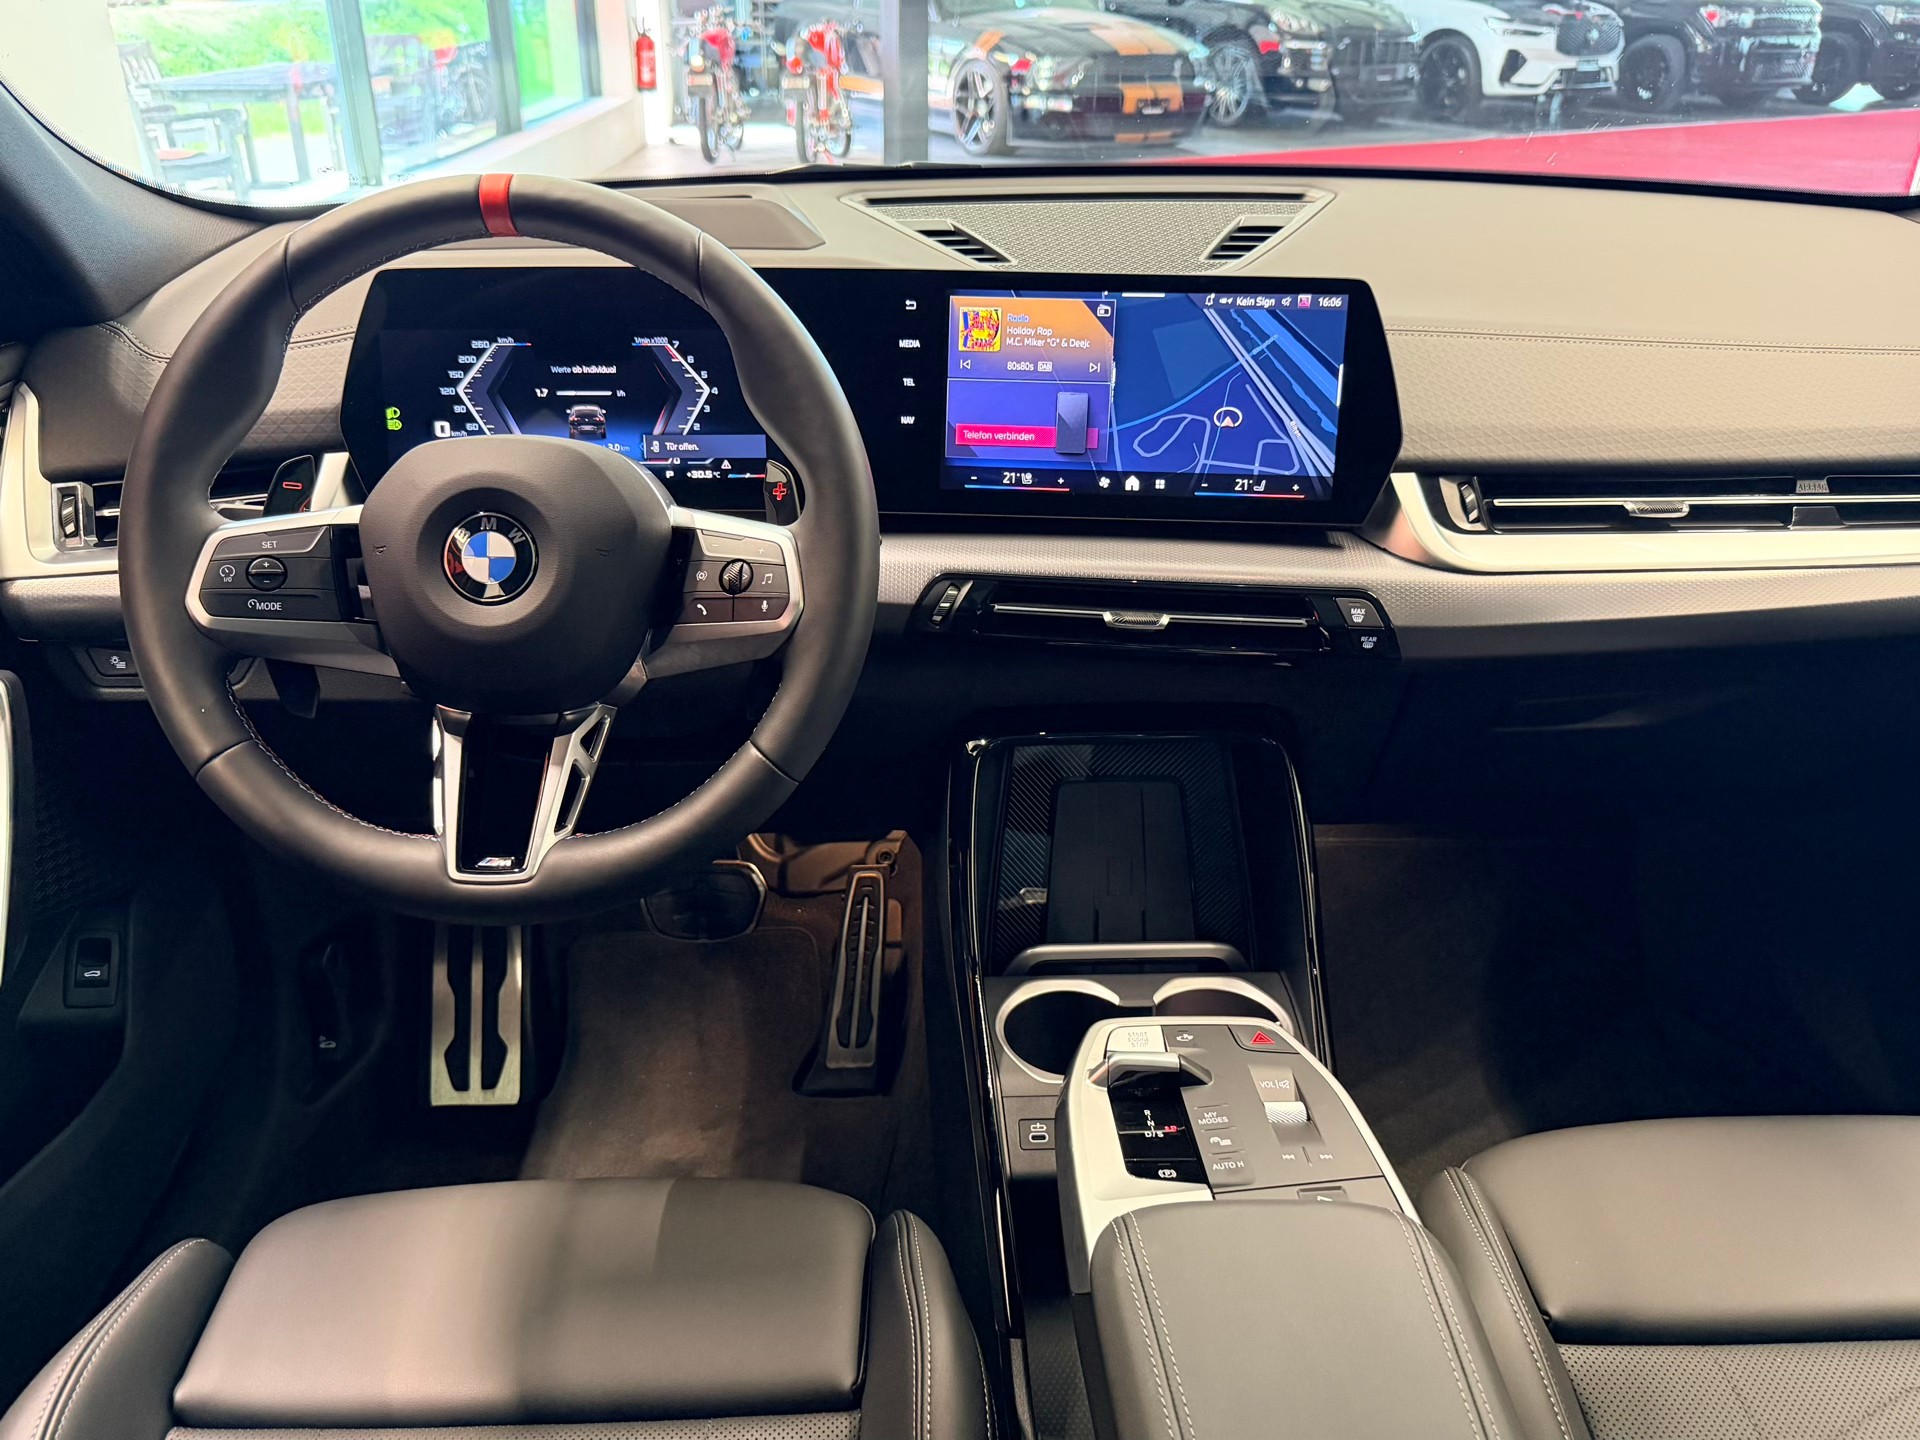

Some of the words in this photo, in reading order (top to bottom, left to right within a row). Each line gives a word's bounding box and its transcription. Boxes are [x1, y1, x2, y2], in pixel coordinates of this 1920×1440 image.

[1236, 296, 1255, 306] Kein
[1256, 296, 1275, 308] Sign
[1318, 297, 1342, 307] 16:06
[1007, 313, 1029, 323] Radio
[1006, 326, 1036, 337] Holiday
[1037, 327, 1053, 337] Rap
[497, 336, 514, 344] km/h
[899, 339, 920, 348] MEDIA
[1006, 338, 1022, 346] M.C.
[1024, 338, 1045, 347] Miker
[1061, 339, 1068, 347] &
[471, 341, 490, 349] 260
[672, 341, 679, 349] 7
[458, 356, 477, 364] 200
[687, 356, 694, 364] 6
[550, 365, 571, 373] Werte
[583, 365, 617, 374] Individual
[1007, 361, 1034, 371] 80s80s
[448, 371, 464, 379] 150
[701, 371, 708, 379] 5
[903, 378, 915, 386] TEL
[439, 387, 456, 395] 120
[711, 387, 718, 395] 4
[453, 405, 467, 413] 90
[703, 405, 711, 413] 3
[901, 416, 915, 424] NAV
[434, 421, 450, 437] 0
[466, 423, 479, 431] 60
[693, 423, 700, 431] 2
[963, 430, 992, 439] Telefon
[994, 432, 1035, 441] verbinden
[665, 441, 677, 450] Tür
[686, 470, 712, 479] +30.5
[454, 517, 526, 544] BMW
[262, 541, 277, 549] SET
[256, 602, 282, 611] MODE
[1258, 1080, 1276, 1088] VOL
[1204, 1111, 1217, 1119] MY
[1198, 1116, 1229, 1125] MODES
[1212, 1161, 1236, 1171] AUTO
